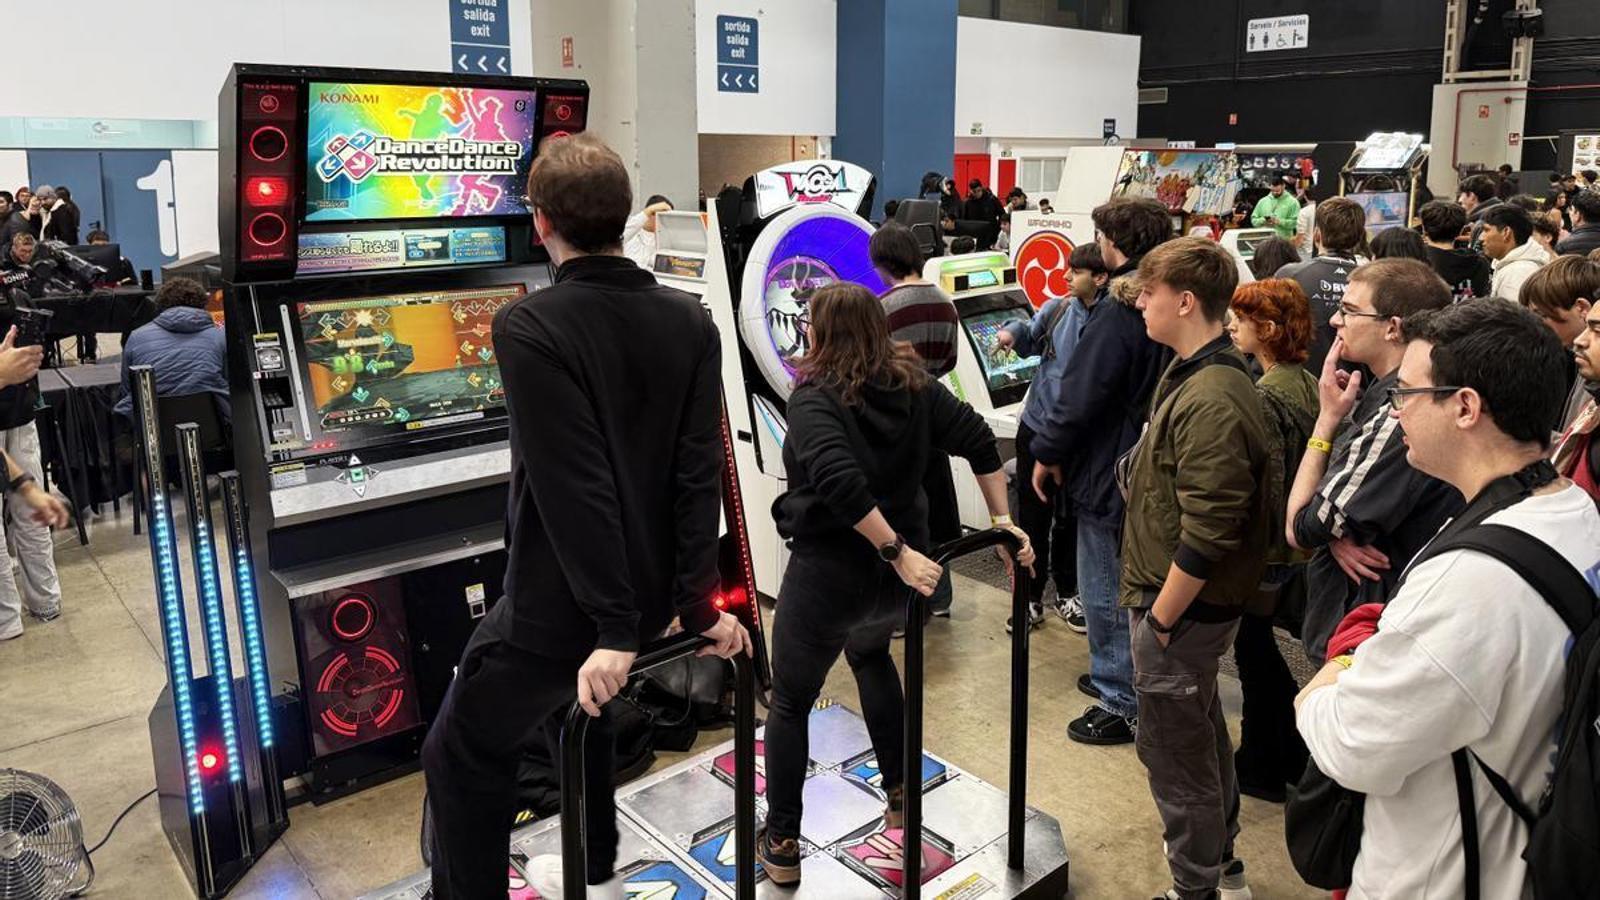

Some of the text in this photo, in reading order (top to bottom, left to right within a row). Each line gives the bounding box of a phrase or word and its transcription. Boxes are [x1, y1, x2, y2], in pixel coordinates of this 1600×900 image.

[463, 9, 496, 22] salida
[470, 25, 491, 37] exit
[724, 21, 752, 33] sortida
[726, 33, 750, 46] salida
[731, 47, 746, 59] exit
[319, 92, 380, 105] KONAMI
[374, 137, 520, 156] DanceDance
[379, 154, 513, 172] Revolution
[136, 159, 178, 257] 1
[1332, 282, 1350, 292] BW
